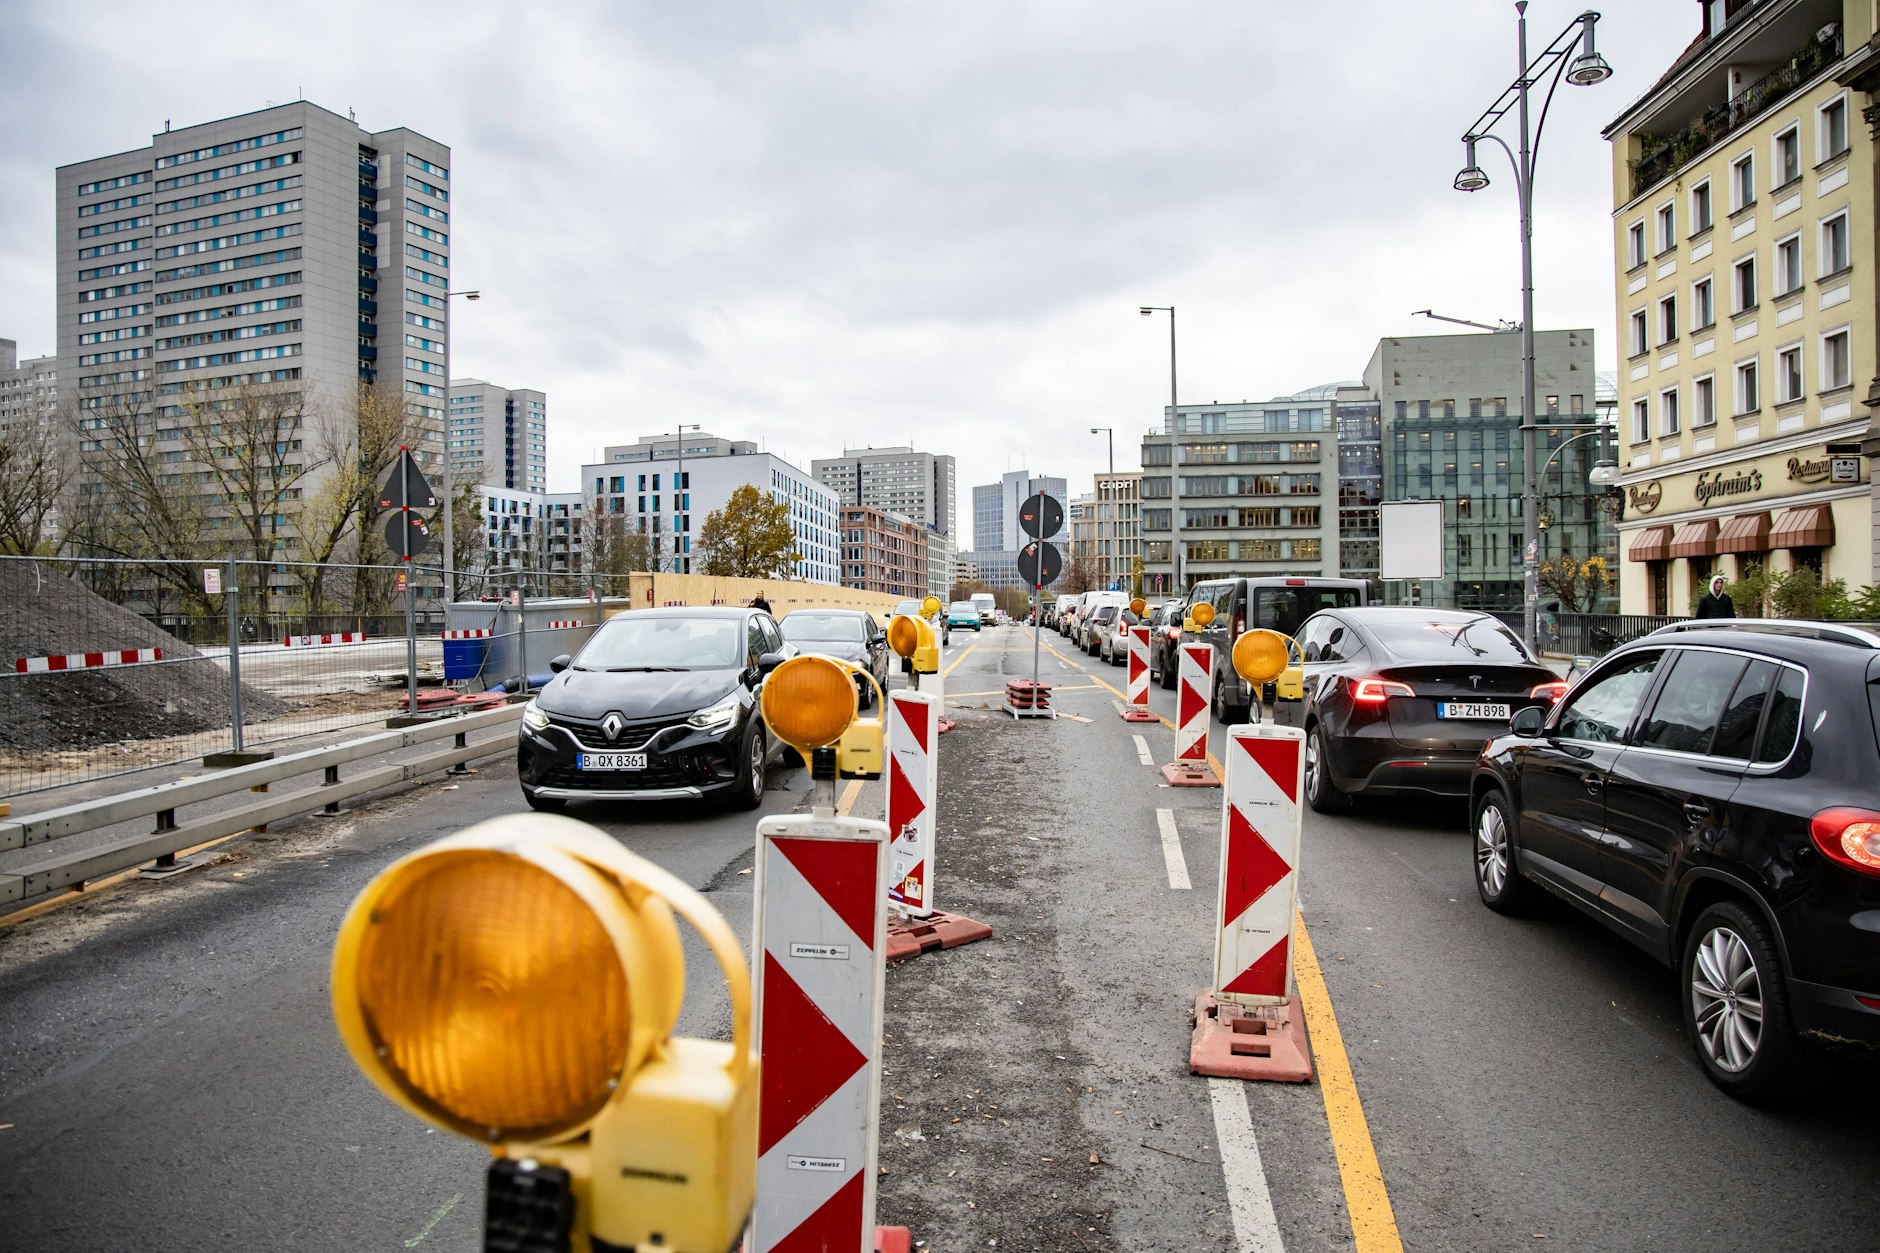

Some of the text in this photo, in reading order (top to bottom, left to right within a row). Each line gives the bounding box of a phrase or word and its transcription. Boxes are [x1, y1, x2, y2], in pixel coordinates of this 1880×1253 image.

[1100, 480, 1133, 490] capri
[1450, 705, 1457, 716] B
[1465, 705, 1481, 716] ZH
[1484, 705, 1505, 717] 898
[584, 756, 645, 767] B QX 8361
